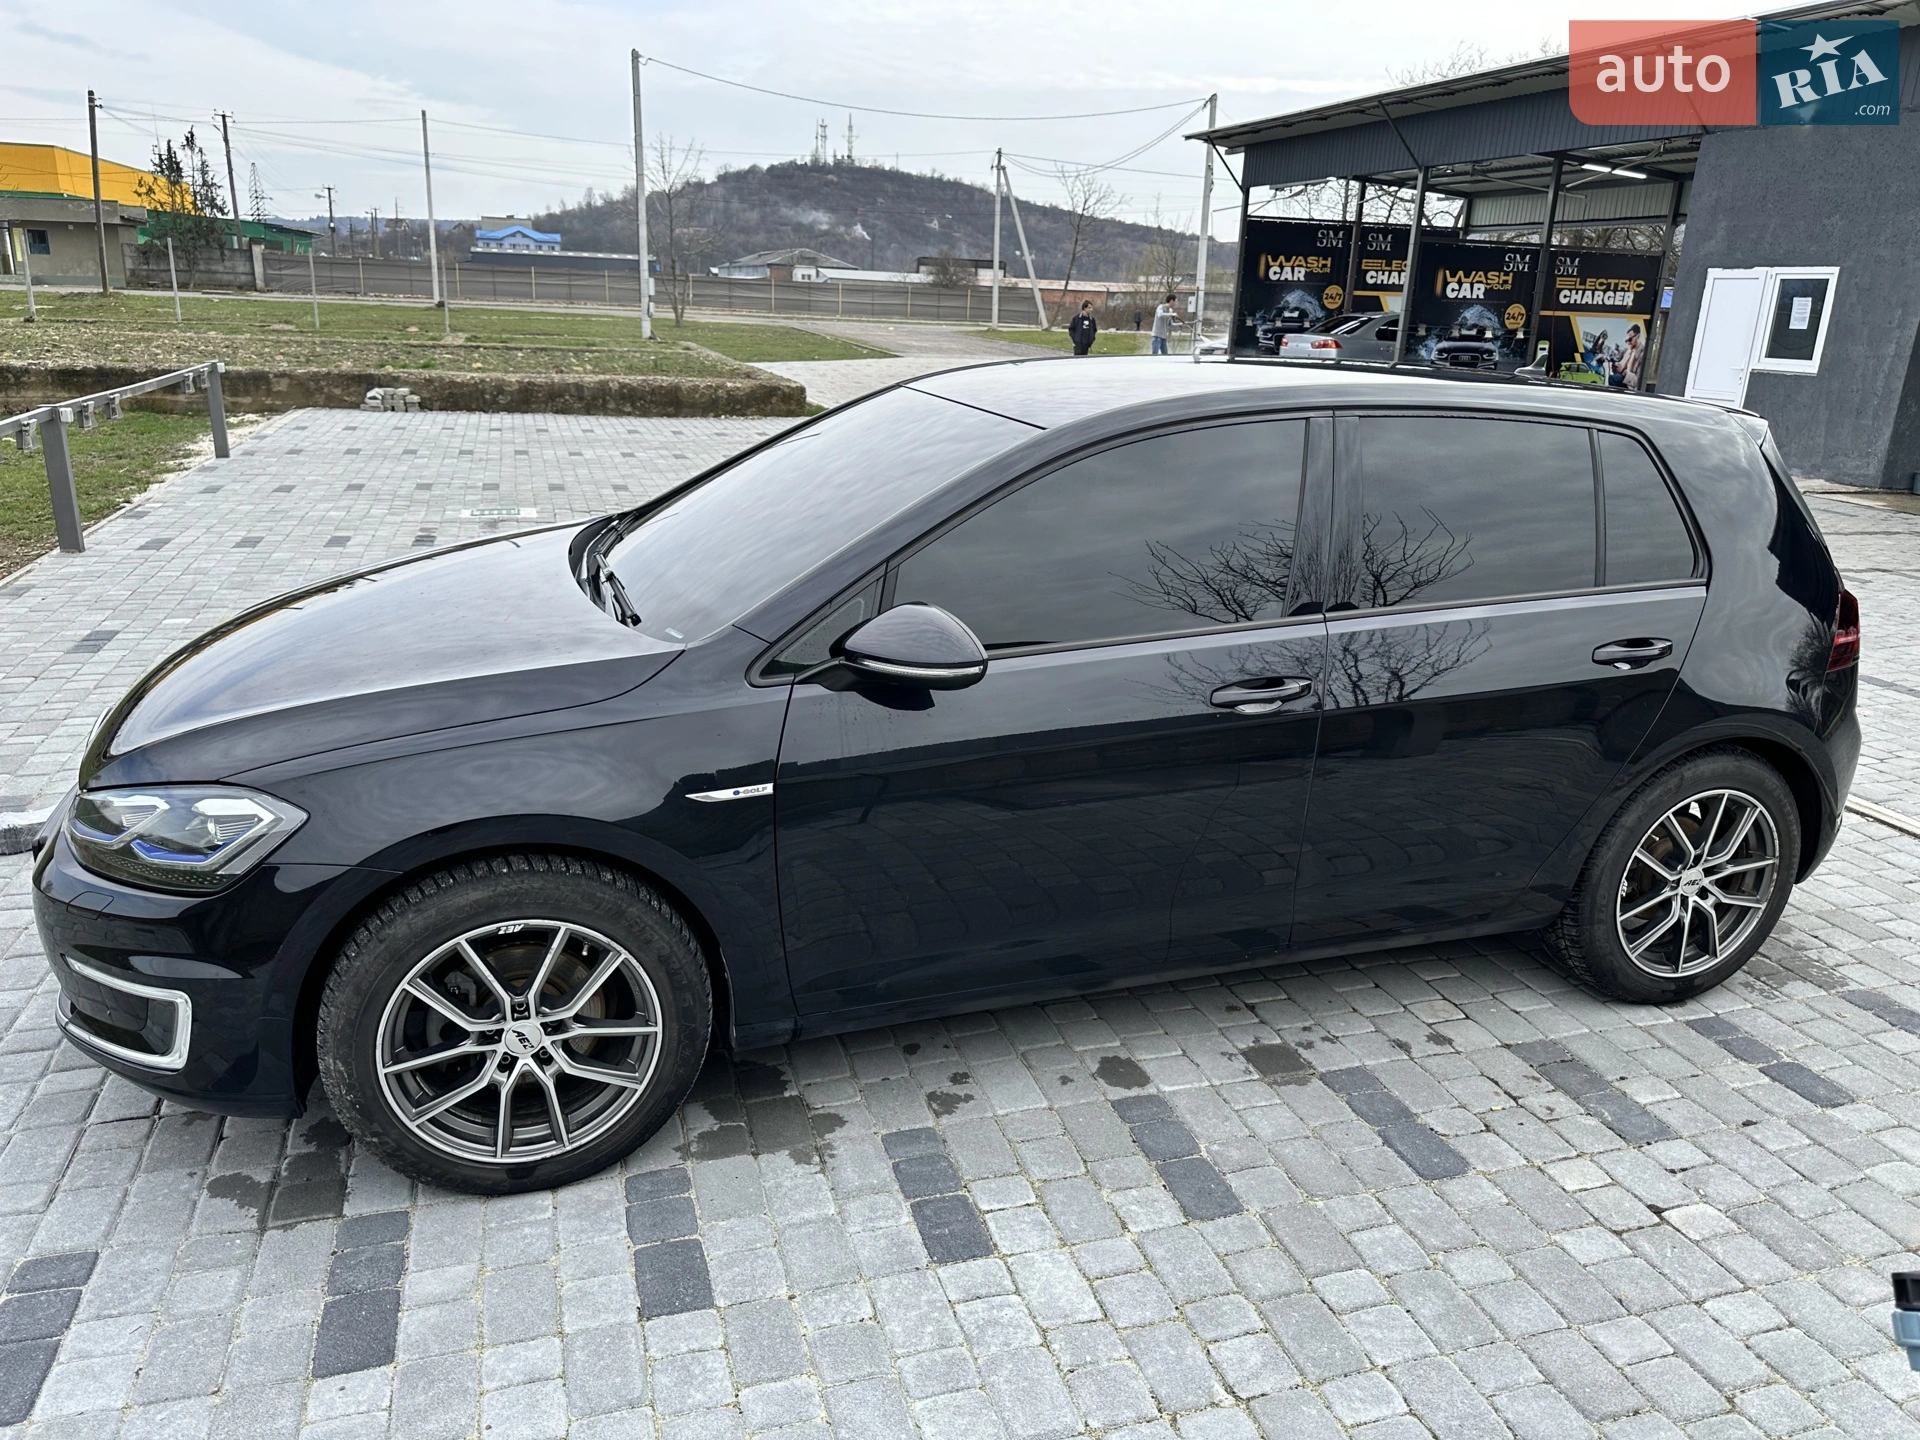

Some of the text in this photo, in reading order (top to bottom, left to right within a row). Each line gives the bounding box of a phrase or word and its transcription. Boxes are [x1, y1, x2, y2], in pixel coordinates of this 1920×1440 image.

[1316, 229, 1345, 248] SM
[1366, 232, 1393, 251] SM
[1267, 255, 1332, 268] WASH
[1503, 253, 1531, 272] SM
[1554, 256, 1580, 276] SM
[1268, 266, 1306, 281] CAR
[1445, 270, 1514, 284] WASH
[1445, 282, 1486, 299] CAR
[1555, 277, 1645, 292] ELECTRIC
[1324, 291, 1343, 302] 24/7
[1558, 289, 1634, 306] CHARGER
[1505, 312, 1525, 321] 24/7
[511, 1029, 535, 1050] AEZ
